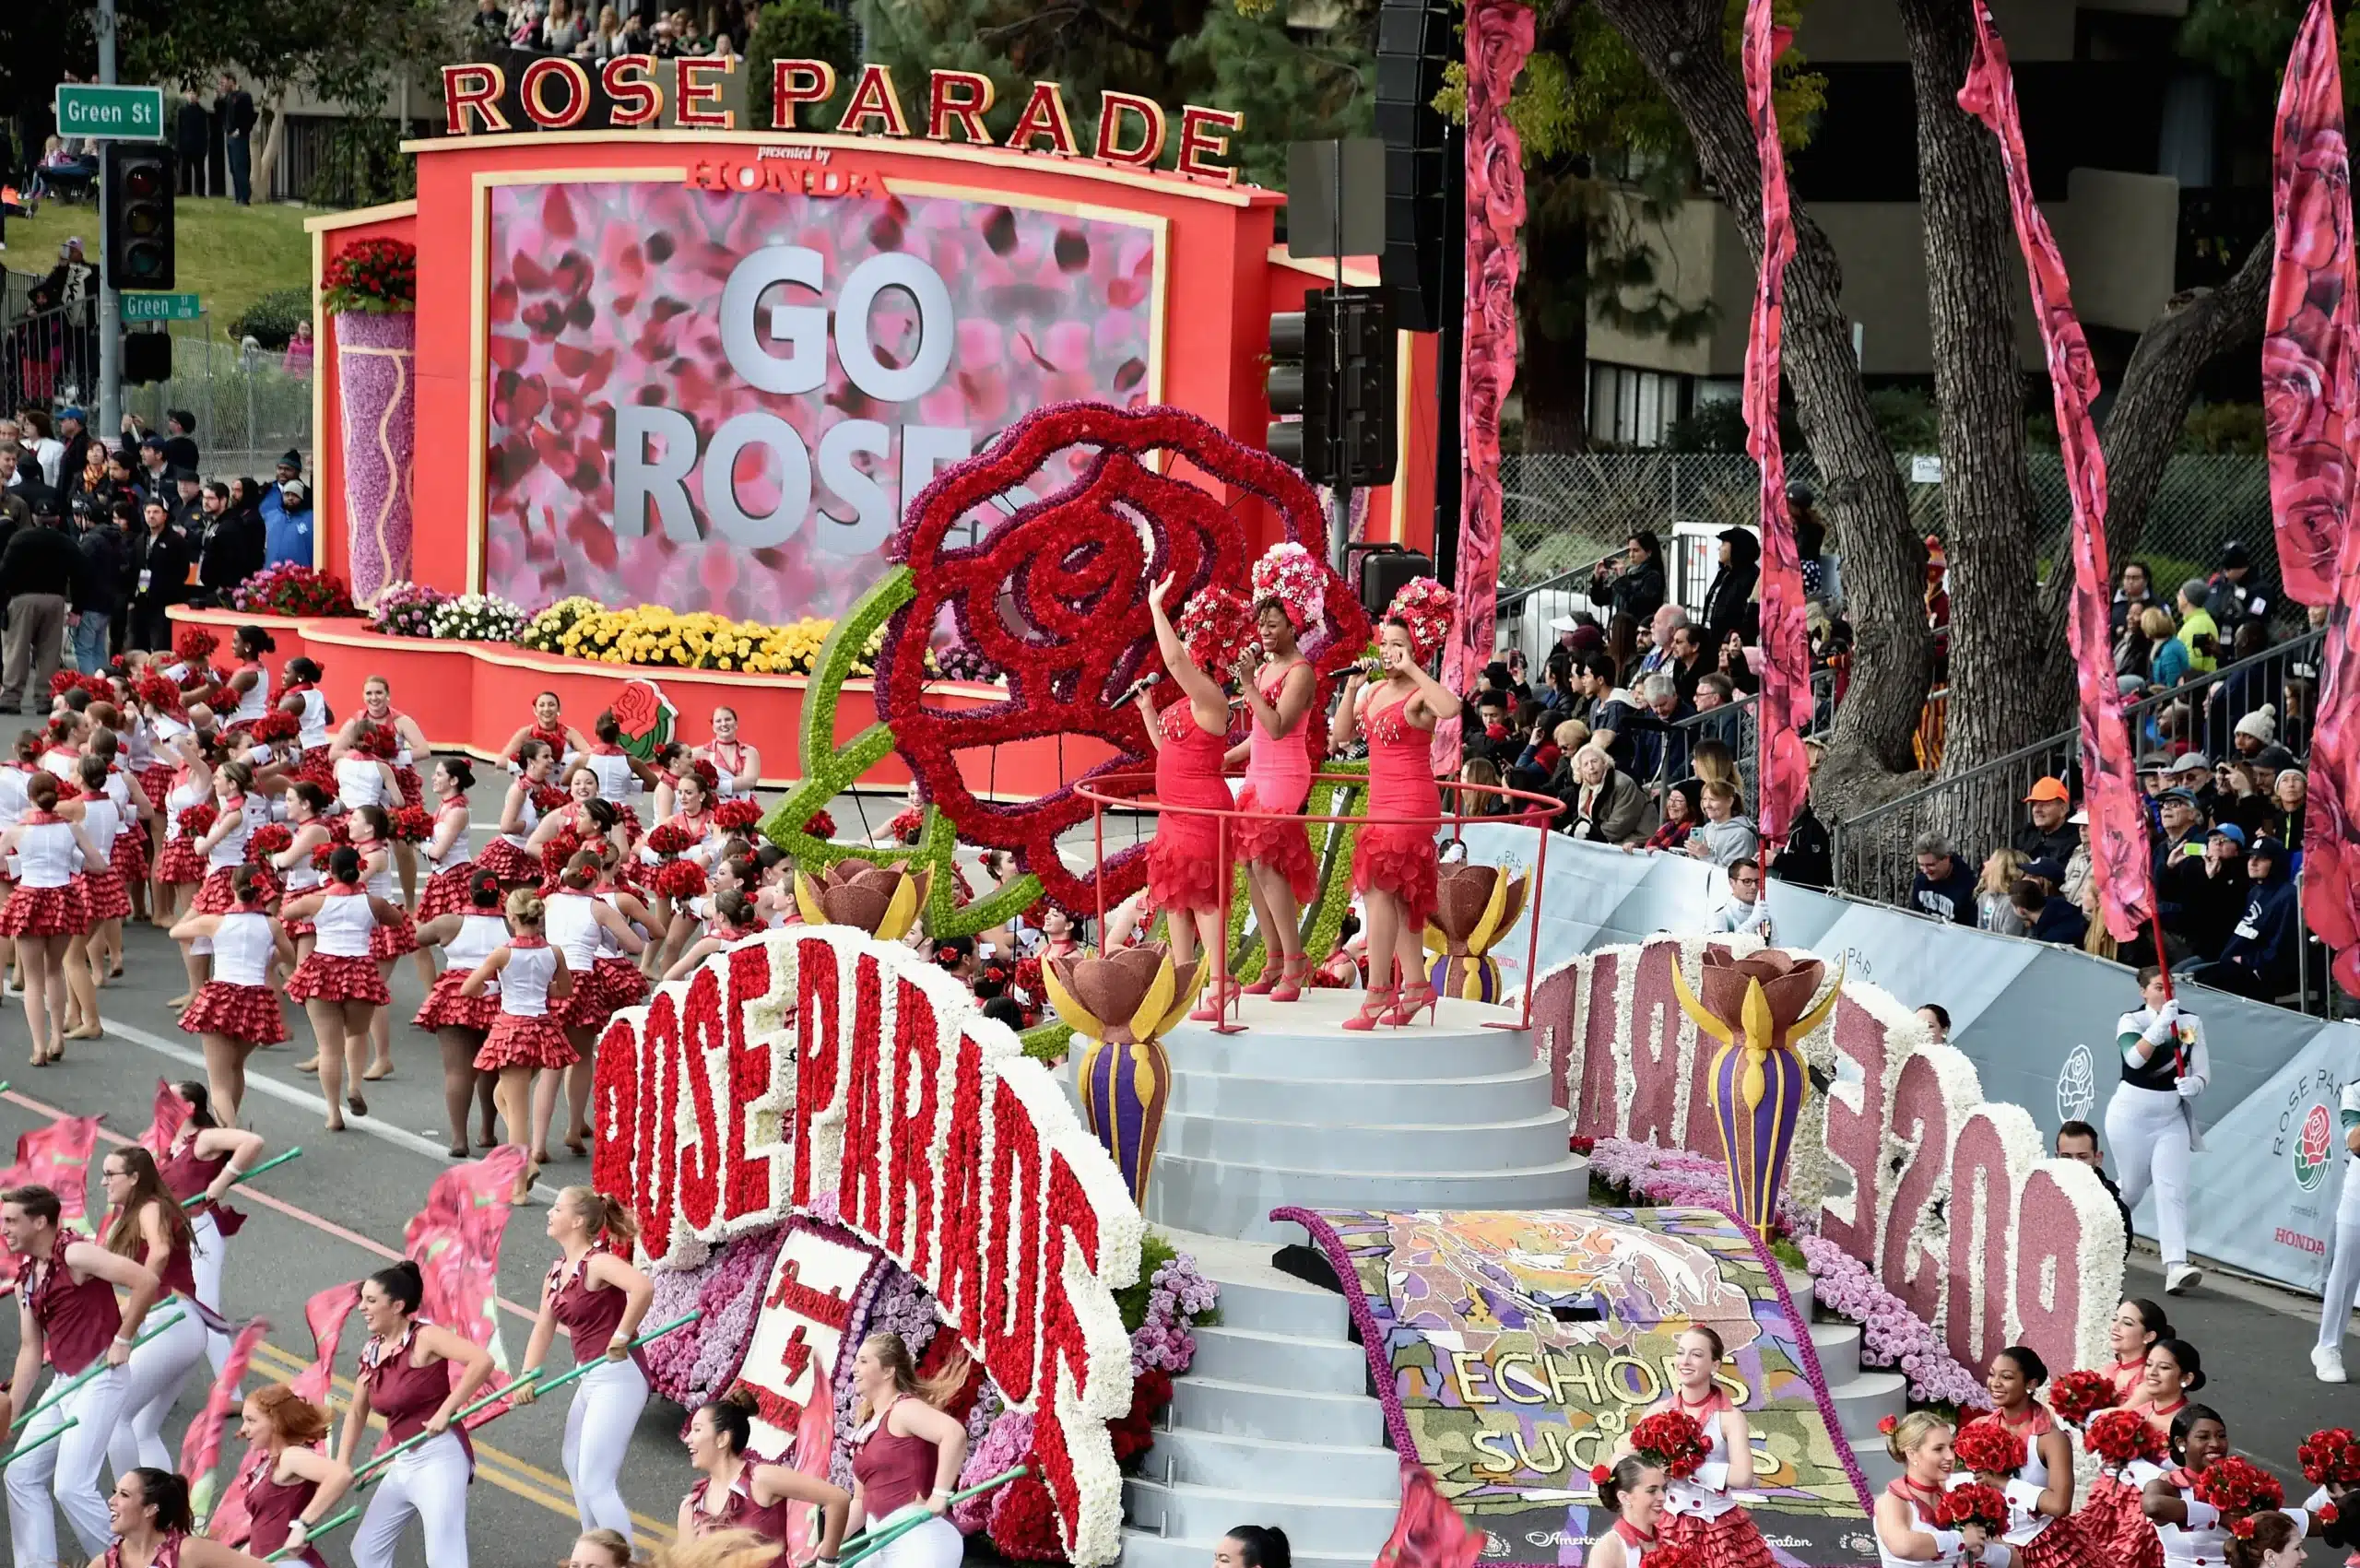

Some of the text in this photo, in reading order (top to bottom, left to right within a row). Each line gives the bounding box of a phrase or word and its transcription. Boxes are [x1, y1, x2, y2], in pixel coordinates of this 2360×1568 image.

[67, 100, 152, 124] Green St
[441, 53, 1245, 188] ROSE PARADE
[757, 146, 831, 167] presented by
[684, 159, 891, 200] HONDA
[127, 295, 170, 315] Green
[719, 244, 955, 402] GO
[1497, 955, 1519, 970] ONDA
[2272, 1075, 2310, 1157] ROSE
[592, 937, 1100, 1550] ROSE PARADE
[2274, 1227, 2326, 1256] HONDA
[1596, 1402, 1633, 1433] of
[1471, 1428, 1782, 1475] SUCS
